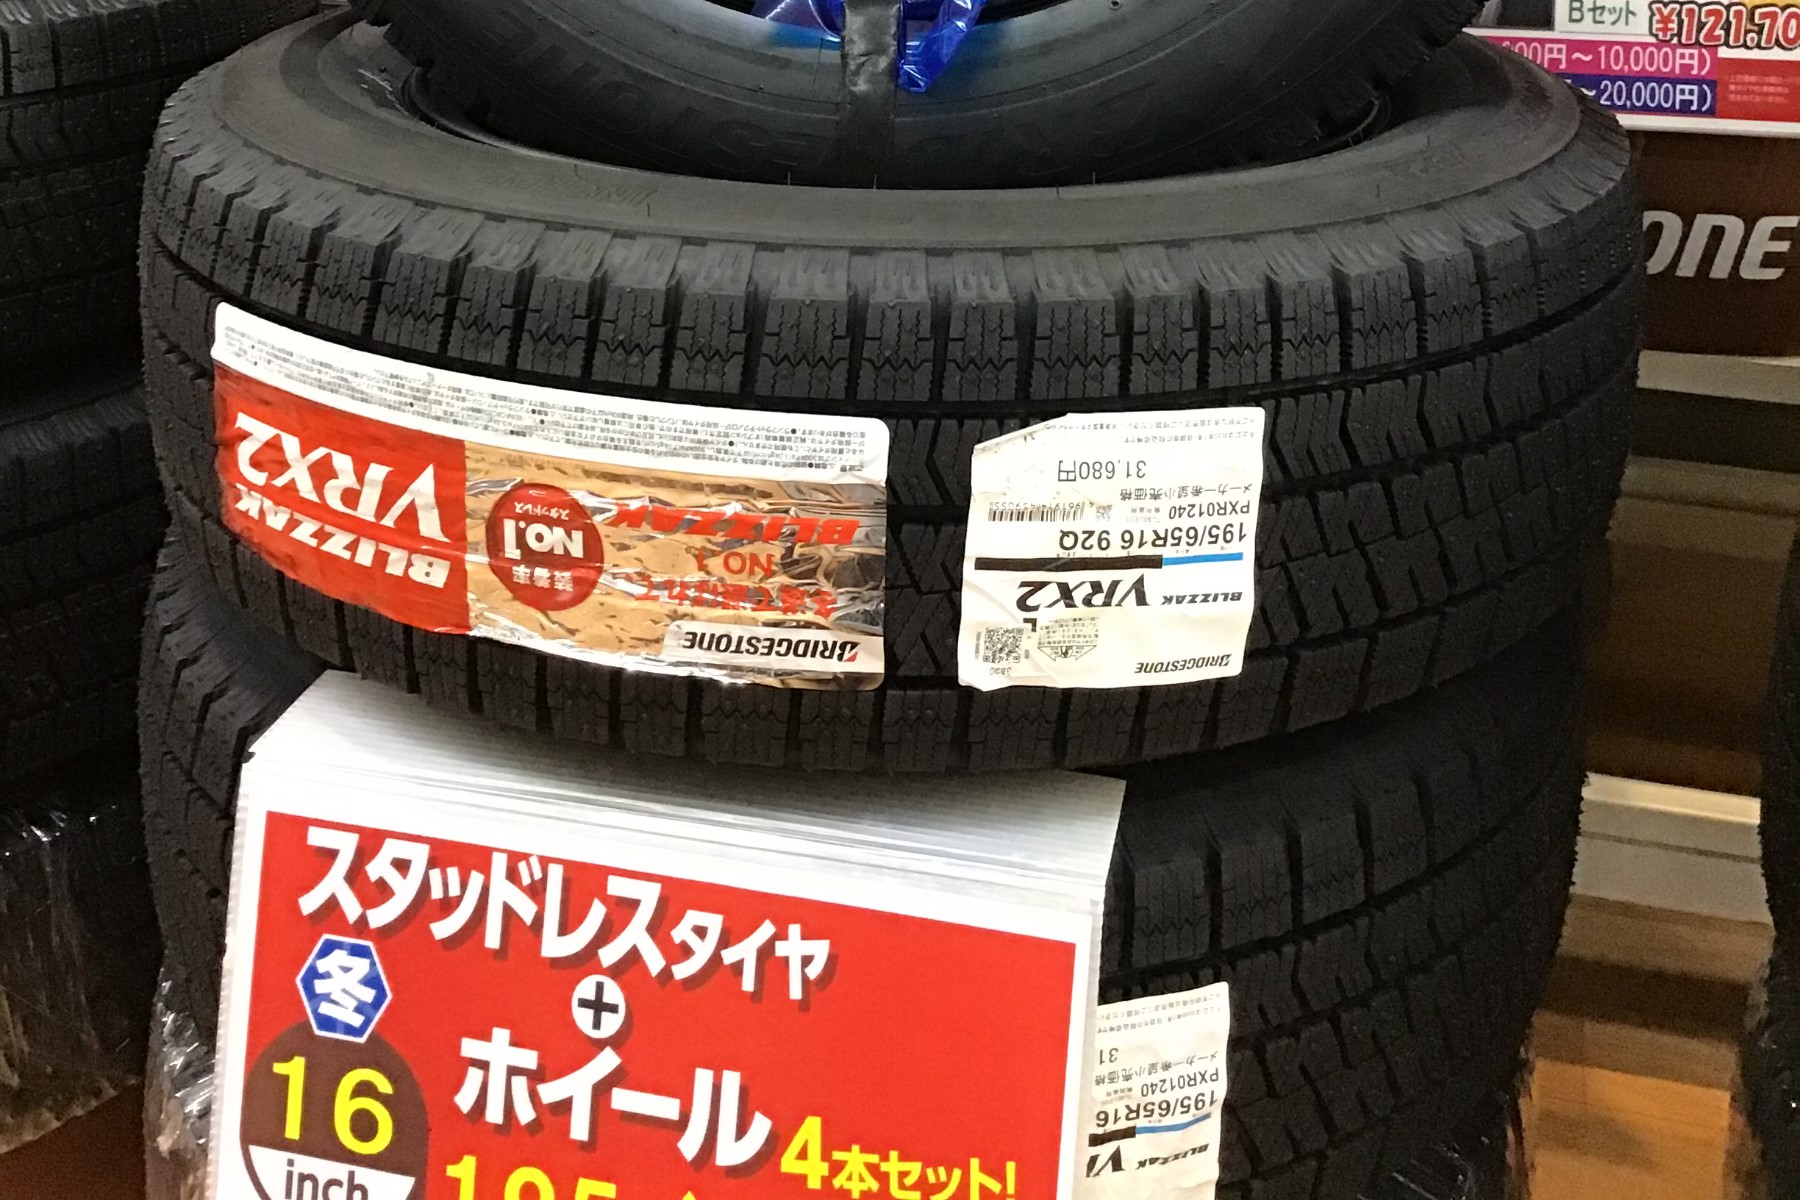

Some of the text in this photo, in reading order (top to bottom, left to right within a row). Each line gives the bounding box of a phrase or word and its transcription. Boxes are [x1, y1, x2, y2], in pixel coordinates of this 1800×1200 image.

[231, 410, 452, 544] VRX2
[1057, 459, 1147, 483] 31,680円
[1119, 482, 1254, 502] メーカー希望小売価格
[1168, 499, 1251, 521] PXR01240
[232, 487, 451, 590] BLIZZAK
[502, 517, 585, 559] NO.1
[604, 503, 862, 548] BLIZZAK
[1058, 522, 1248, 551] 195/65R16 92Q
[1015, 573, 1243, 613] BLIZZAK VRX2
[683, 631, 861, 663] BRIDGESTONE
[1134, 652, 1233, 676] BRIDGESTONE
[298, 825, 832, 1001] スタッドレスタイヤ
[312, 946, 379, 1031] 冬
[453, 1026, 773, 1168] ホイール
[1139, 1067, 1220, 1098] PXR01240
[272, 1055, 395, 1156] 16
[1095, 1089, 1218, 1128] 195/65R16
[1134, 1143, 1210, 1171] BLIZZAK
